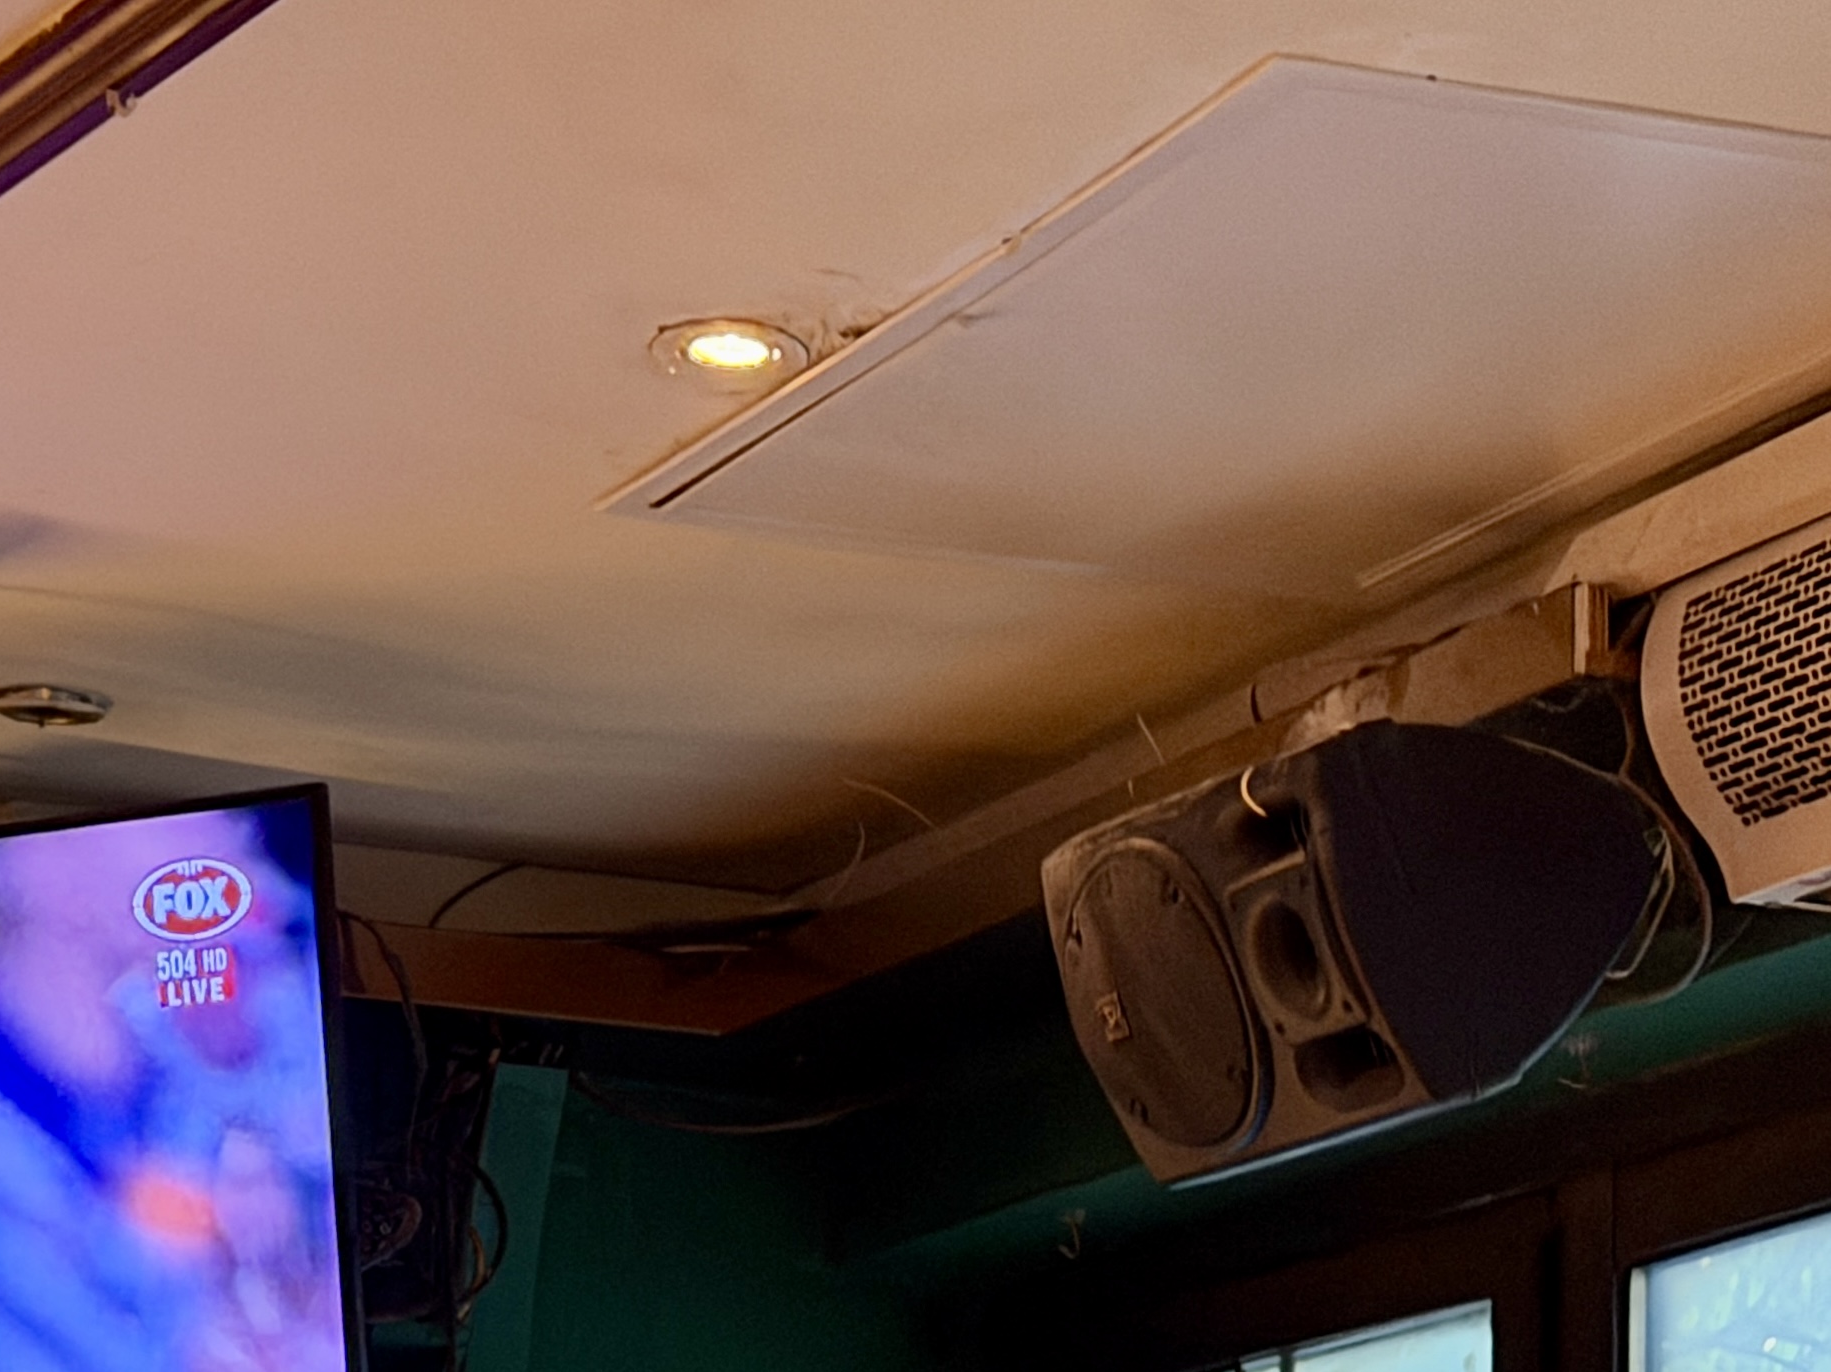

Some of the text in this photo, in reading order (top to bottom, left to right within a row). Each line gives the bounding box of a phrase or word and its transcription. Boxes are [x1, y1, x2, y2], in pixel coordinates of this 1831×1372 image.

[152, 875, 231, 924] FOX
[157, 947, 228, 981] 504 HD
[167, 976, 225, 1007] LIVE
